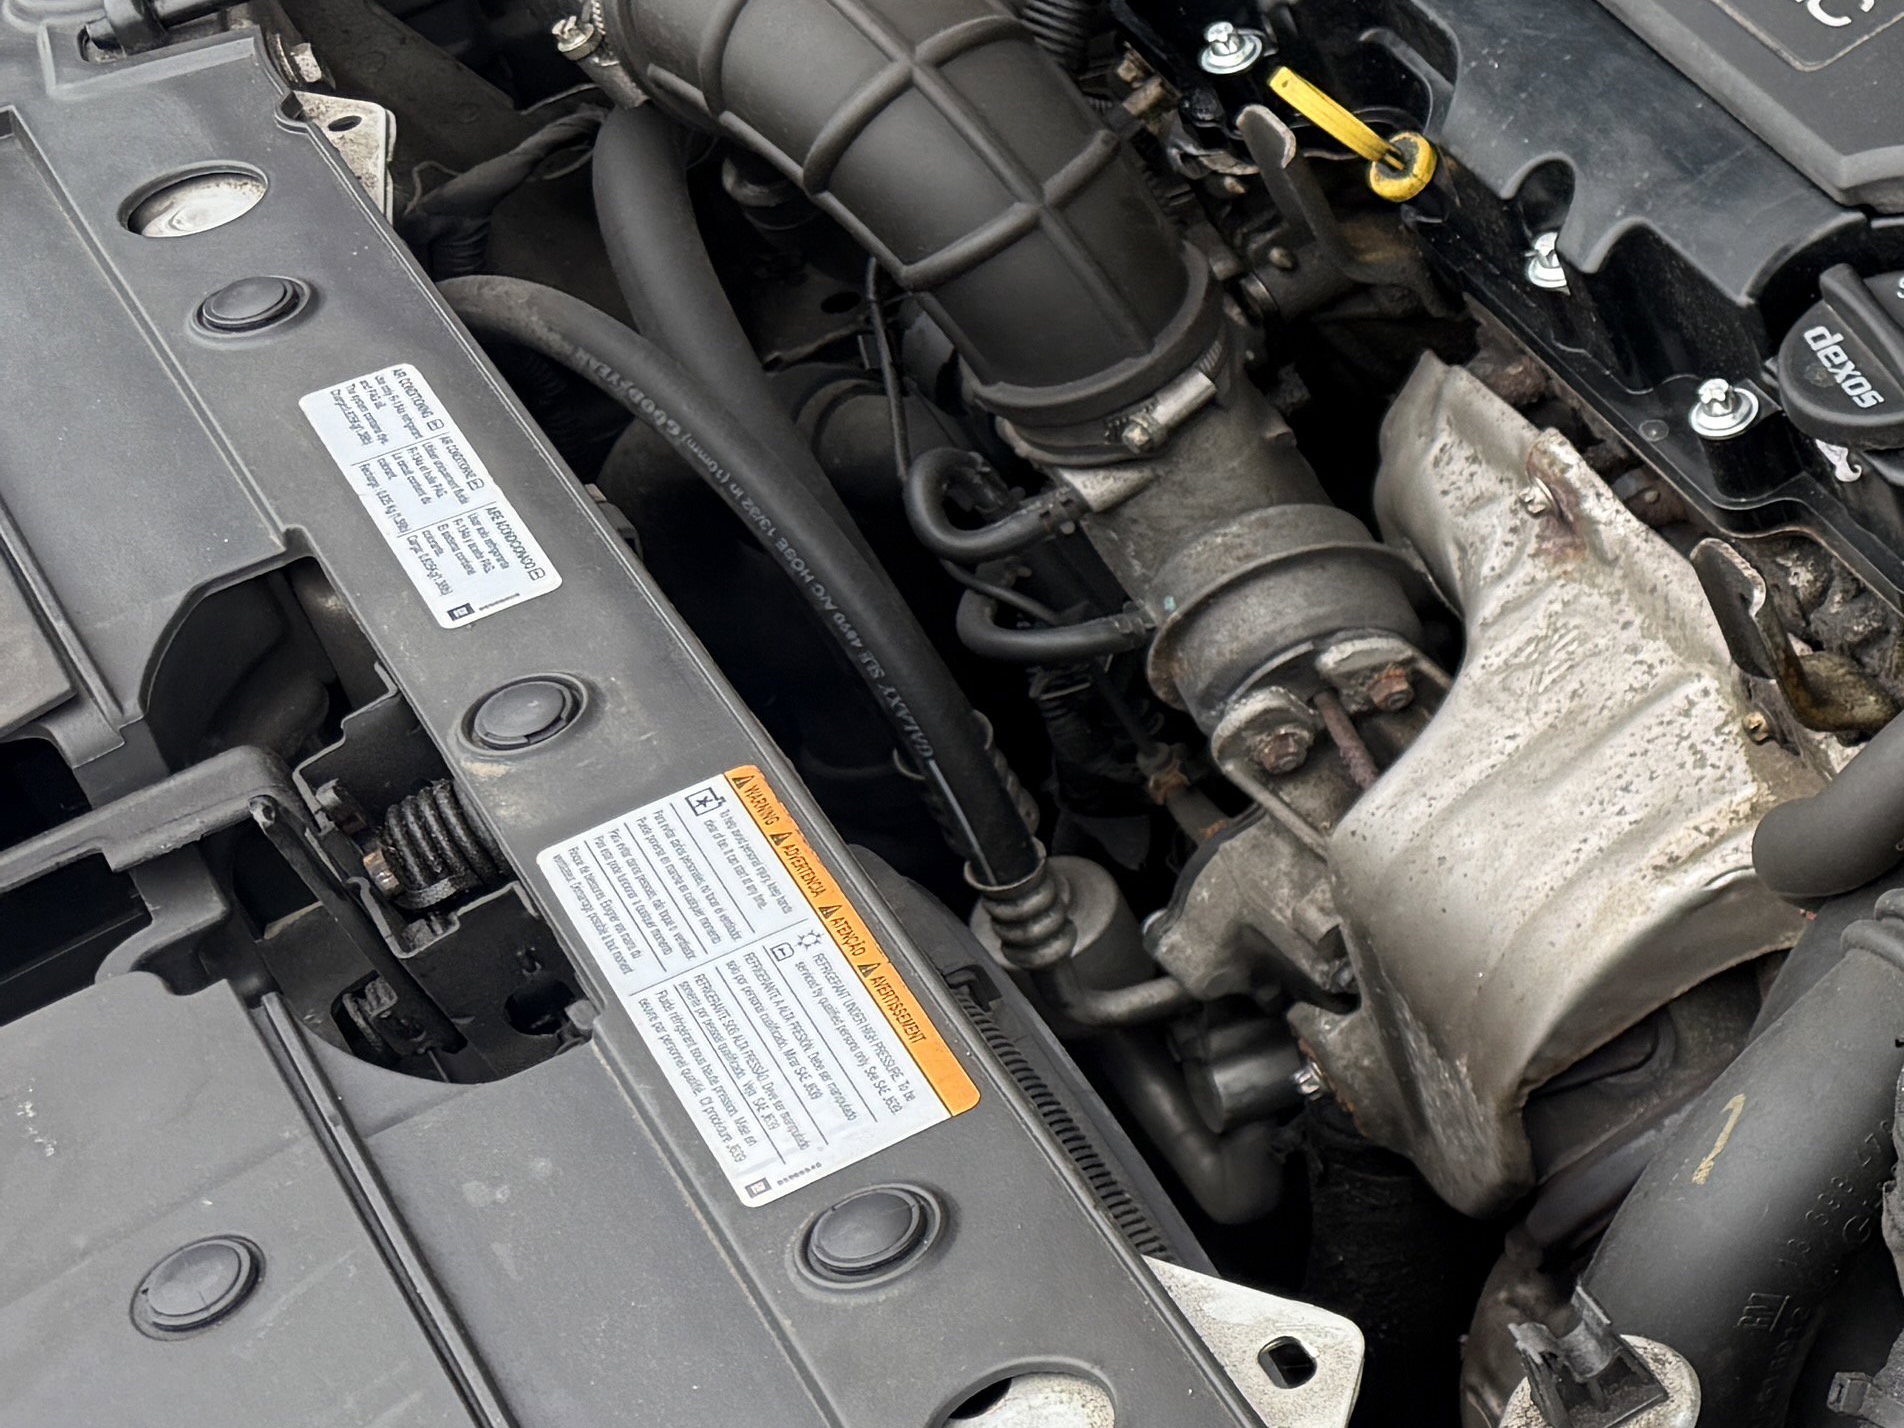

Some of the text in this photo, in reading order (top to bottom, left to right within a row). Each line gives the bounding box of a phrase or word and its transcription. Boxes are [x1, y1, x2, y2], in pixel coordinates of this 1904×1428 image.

[1800, 322, 1888, 412] dexos
[397, 377, 434, 418] CONDITIONING
[775, 537, 815, 584] HOSE
[743, 785, 779, 826] WARNING
[780, 841, 827, 897] ADVERTENCIA
[826, 914, 868, 958] ATENÇÃO
[741, 951, 782, 1000] REFRIGERANTE
[810, 951, 852, 1001] REFRIGERANT
[841, 997, 868, 1026] UNDER
[858, 1022, 880, 1044] HIGH
[868, 974, 926, 1045] AVERTISSEMENT
